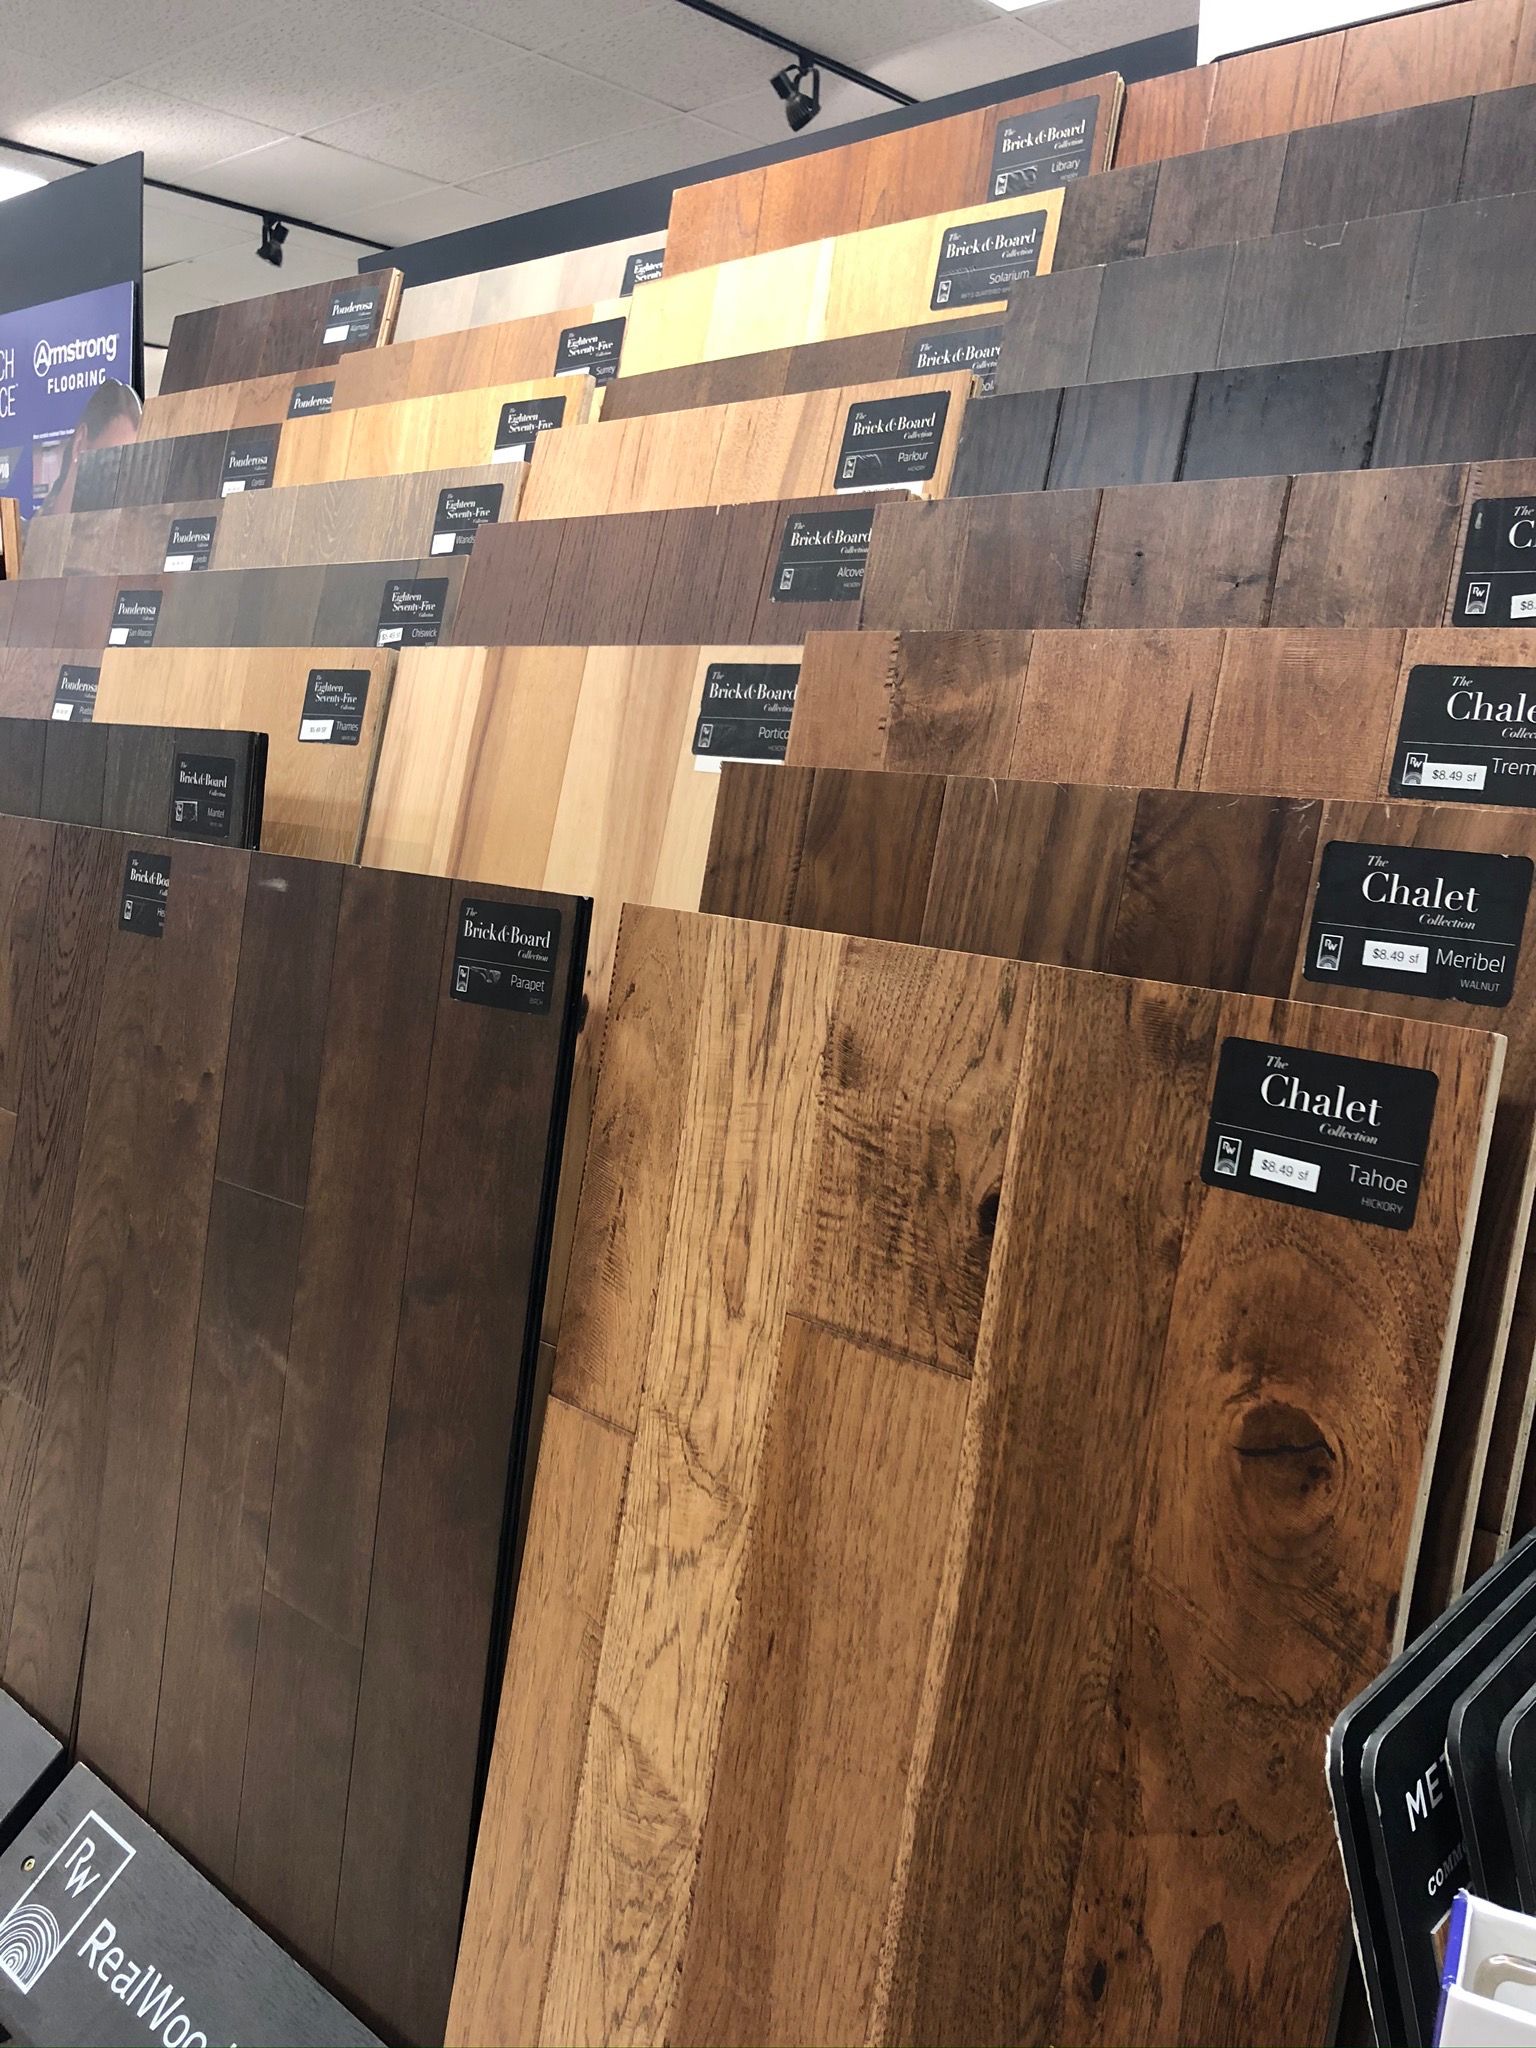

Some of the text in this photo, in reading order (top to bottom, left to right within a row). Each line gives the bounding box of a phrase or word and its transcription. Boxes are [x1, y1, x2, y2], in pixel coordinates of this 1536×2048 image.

[1004, 128, 1016, 137] The
[1051, 159, 1081, 173] Library
[948, 232, 961, 242] The
[1001, 247, 1033, 259] Collection
[989, 269, 1030, 285] Solarium
[332, 301, 373, 316] Ponderosa
[567, 336, 598, 349] Eighteen
[568, 340, 614, 357] Seventy-Five
[920, 343, 933, 352] The
[34, 333, 116, 377] Armstrong
[596, 366, 616, 376] Surrey
[47, 368, 106, 394] FLOORING
[293, 395, 333, 409] Ponderosa
[508, 413, 538, 425] Eighteen
[855, 412, 867, 420] The
[508, 420, 554, 433] Seventy-Five
[903, 430, 933, 440] Collection
[229, 454, 268, 468] Ponderosa
[897, 451, 929, 463] Parlour
[445, 499, 476, 511] Eighteen
[1513, 505, 1535, 517] The
[446, 507, 491, 520] Seventy-Five
[793, 522, 806, 530] The
[173, 530, 210, 544] Ponderosa
[837, 567, 865, 577] Alcove
[391, 591, 422, 604] Eighteen
[118, 602, 156, 615] Ponderosa
[392, 600, 436, 614] Seventy-Five
[411, 627, 438, 638] Chiswick
[712, 671, 725, 680] The
[1451, 675, 1474, 687] The
[314, 681, 344, 694] Eighteen
[315, 692, 358, 706] Seventy-Five
[336, 720, 359, 732] Thames
[758, 726, 790, 740] Portico
[1431, 769, 1477, 782] $8.49 sf
[207, 807, 225, 819] Mantel
[1367, 855, 1390, 868] The
[1361, 871, 1480, 913] Chalet
[465, 906, 478, 917] The
[1418, 913, 1476, 930] Collection
[517, 949, 549, 962] Collection
[1372, 948, 1421, 964] $8.49 sf
[1435, 948, 1506, 973] Meribel
[510, 974, 545, 992] Parapet
[1460, 979, 1500, 992] WALNUT
[1265, 1055, 1289, 1070] The
[1260, 1073, 1383, 1127] Chalet
[1318, 1122, 1378, 1145] Collection
[1261, 1159, 1294, 1177] $8.49
[1348, 1163, 1408, 1194] Tahoe
[1361, 1196, 1404, 1214] HICKORY
[64, 1837, 101, 1899] RW
